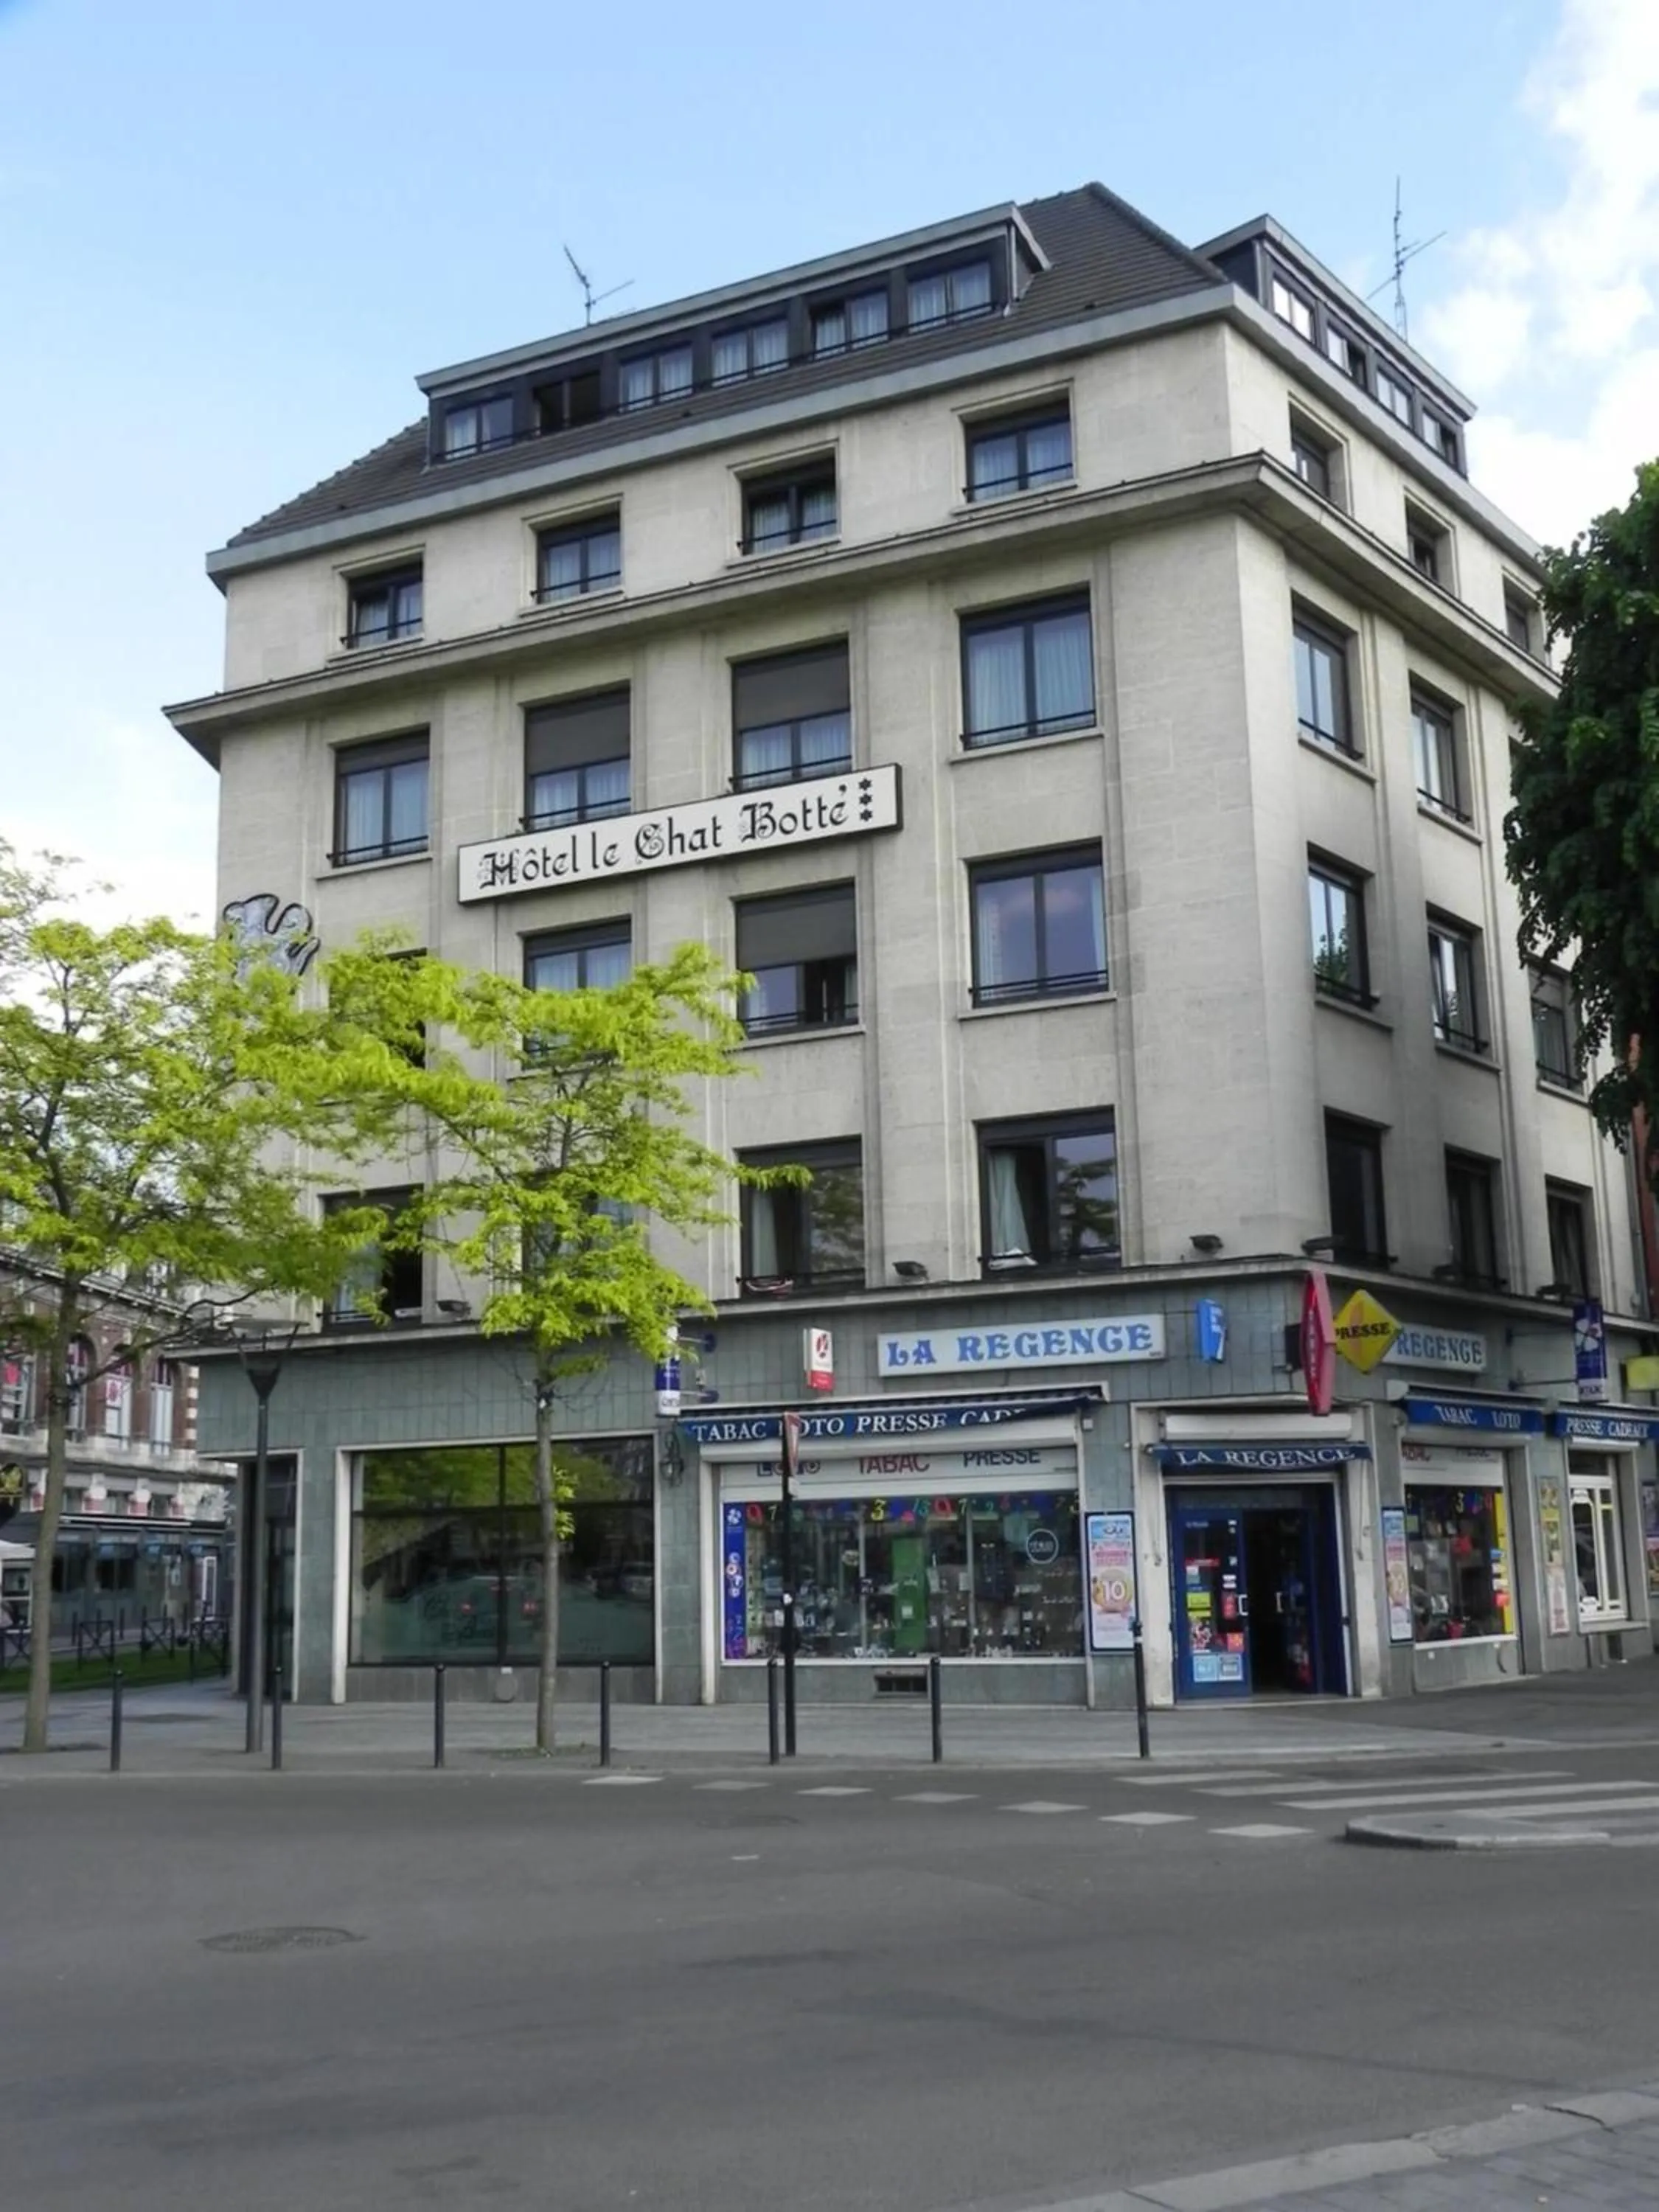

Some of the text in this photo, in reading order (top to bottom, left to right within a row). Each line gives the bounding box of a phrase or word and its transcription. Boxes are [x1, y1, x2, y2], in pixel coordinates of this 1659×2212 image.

[478, 784, 848, 889] Hôtel le Chat Botté
[887, 1324, 1154, 1367] LA REGENCE
[693, 1421, 768, 1442] TABAC
[779, 1416, 845, 1438] OTO
[855, 1413, 947, 1433] PRESSE
[858, 1449, 1041, 1475] TABAC PRESSE
[1178, 1448, 1355, 1467] LA REGENCE
